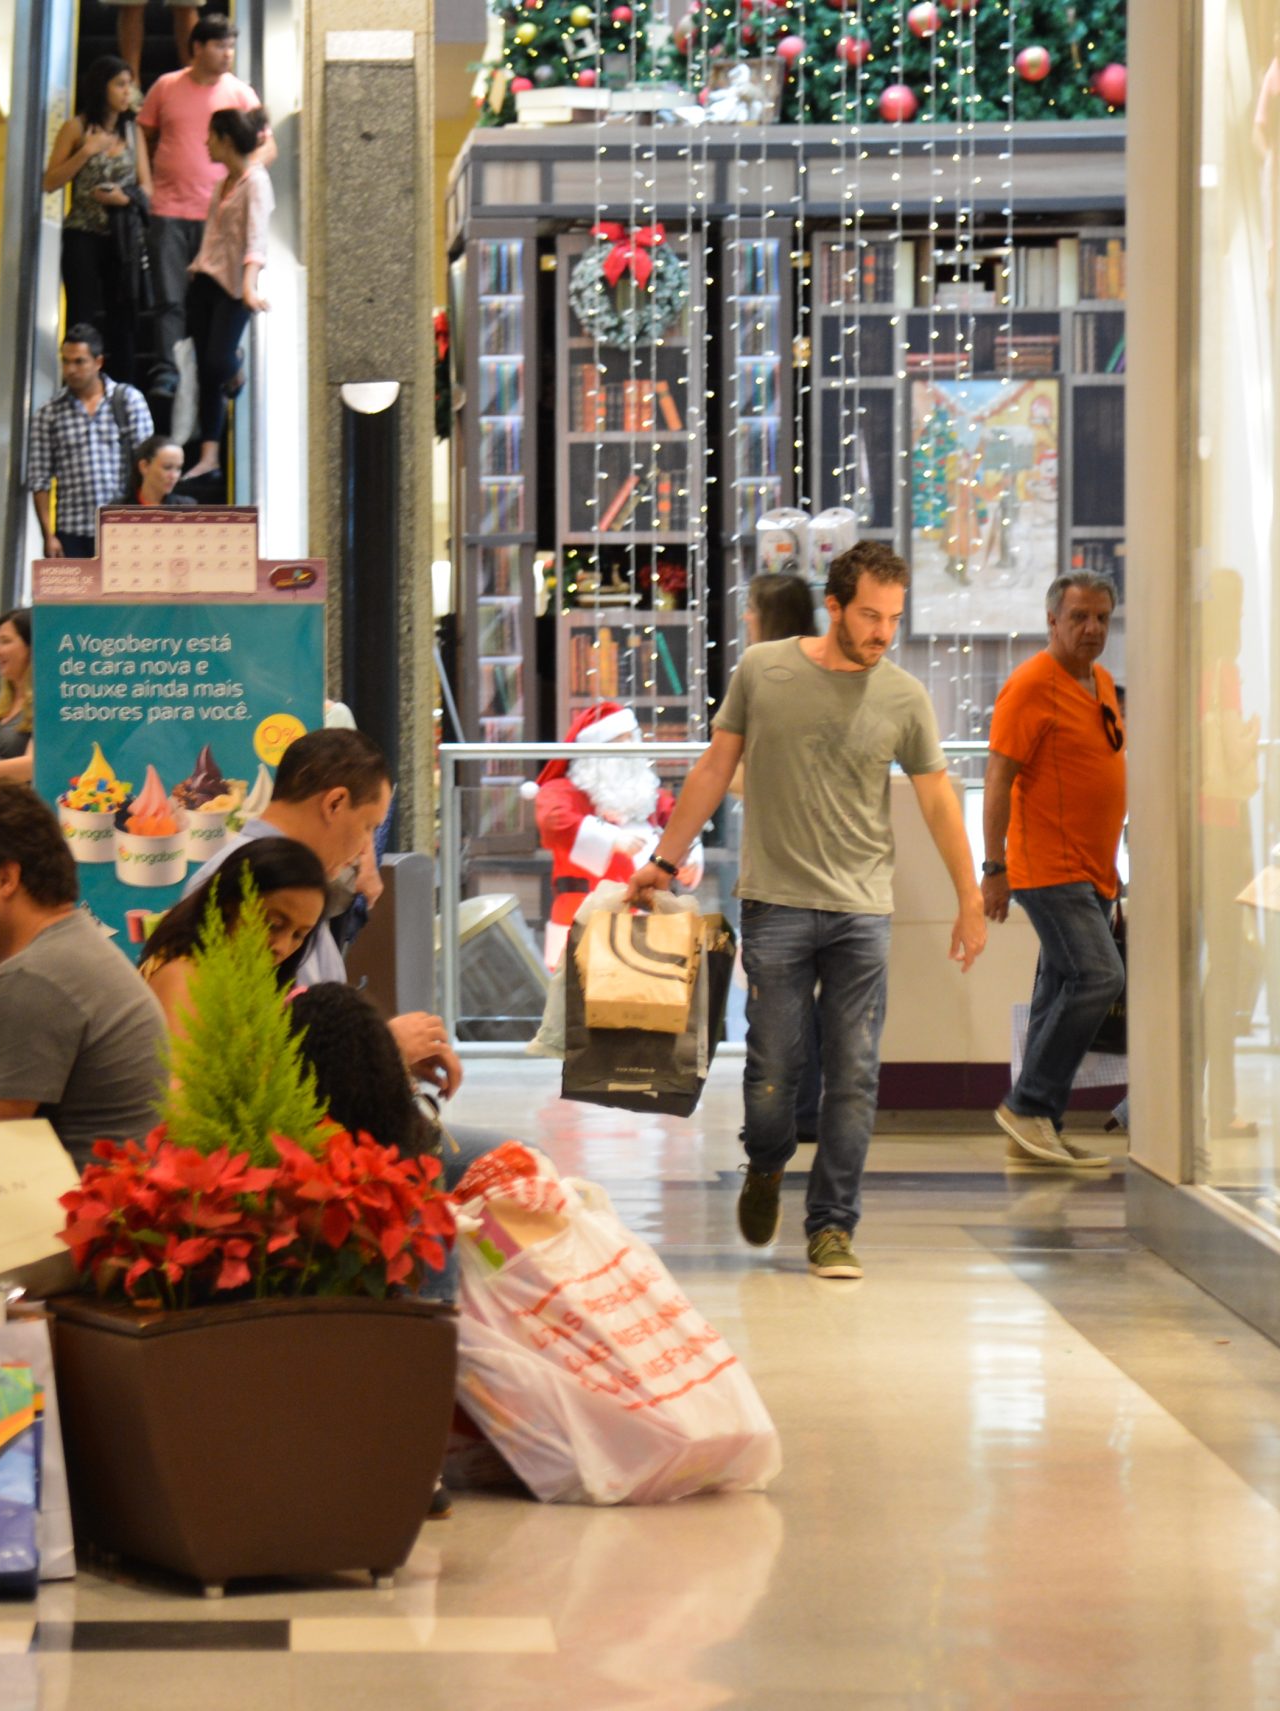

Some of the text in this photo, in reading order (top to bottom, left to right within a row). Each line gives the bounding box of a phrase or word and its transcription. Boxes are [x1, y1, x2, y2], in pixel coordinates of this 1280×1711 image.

[58, 632, 232, 657] A Yogoberry está
[59, 657, 209, 676] de cara nova e
[59, 679, 244, 699] trouxe ainda mais
[59, 701, 253, 725] sabores para você.
